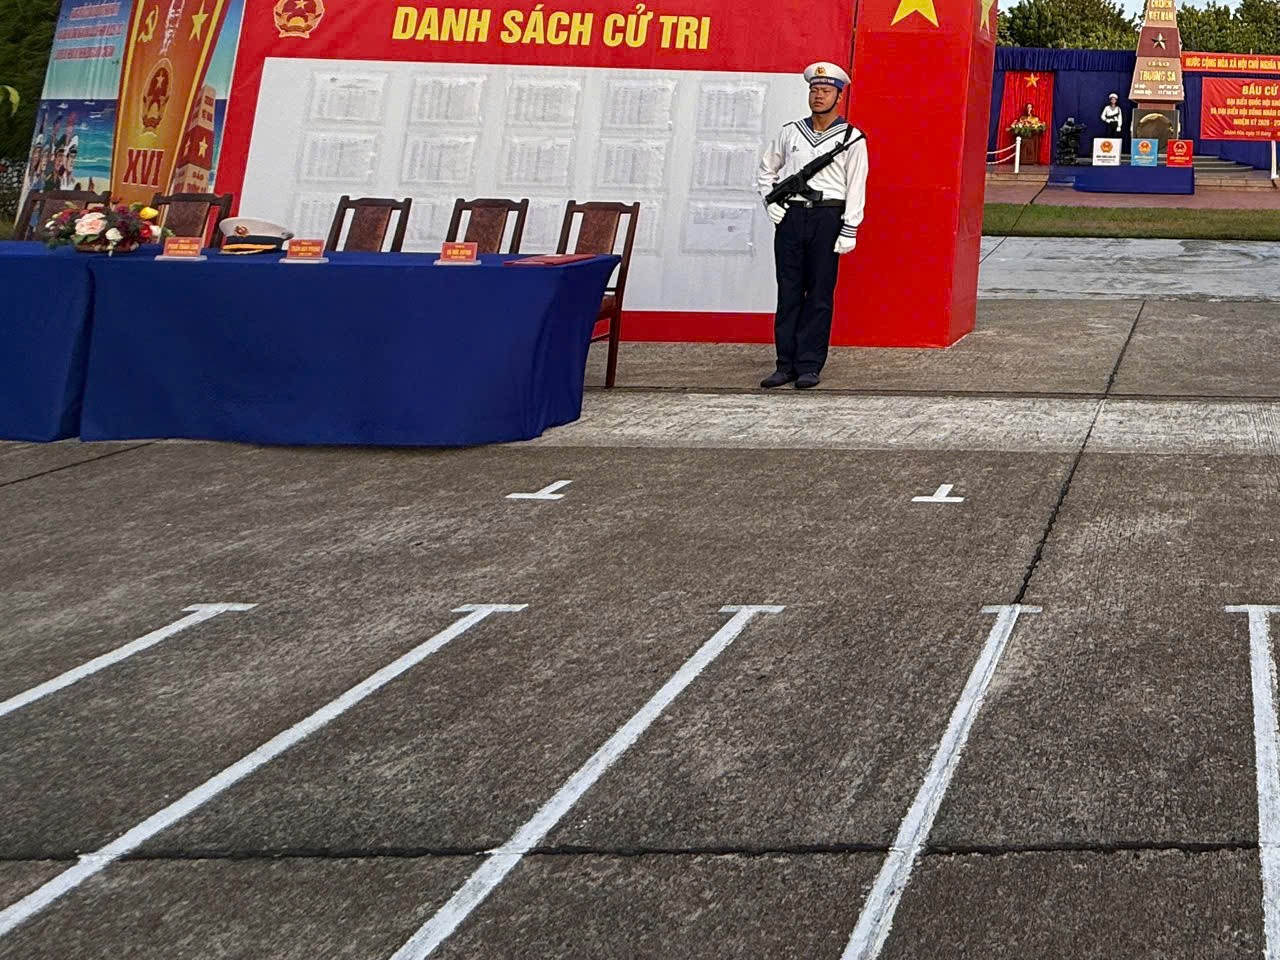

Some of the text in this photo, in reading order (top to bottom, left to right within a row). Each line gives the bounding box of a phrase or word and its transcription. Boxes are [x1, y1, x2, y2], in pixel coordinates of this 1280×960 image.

[392, 3, 710, 49] DANH SÁCH CỬ TRI
[123, 148, 164, 187] XVI
